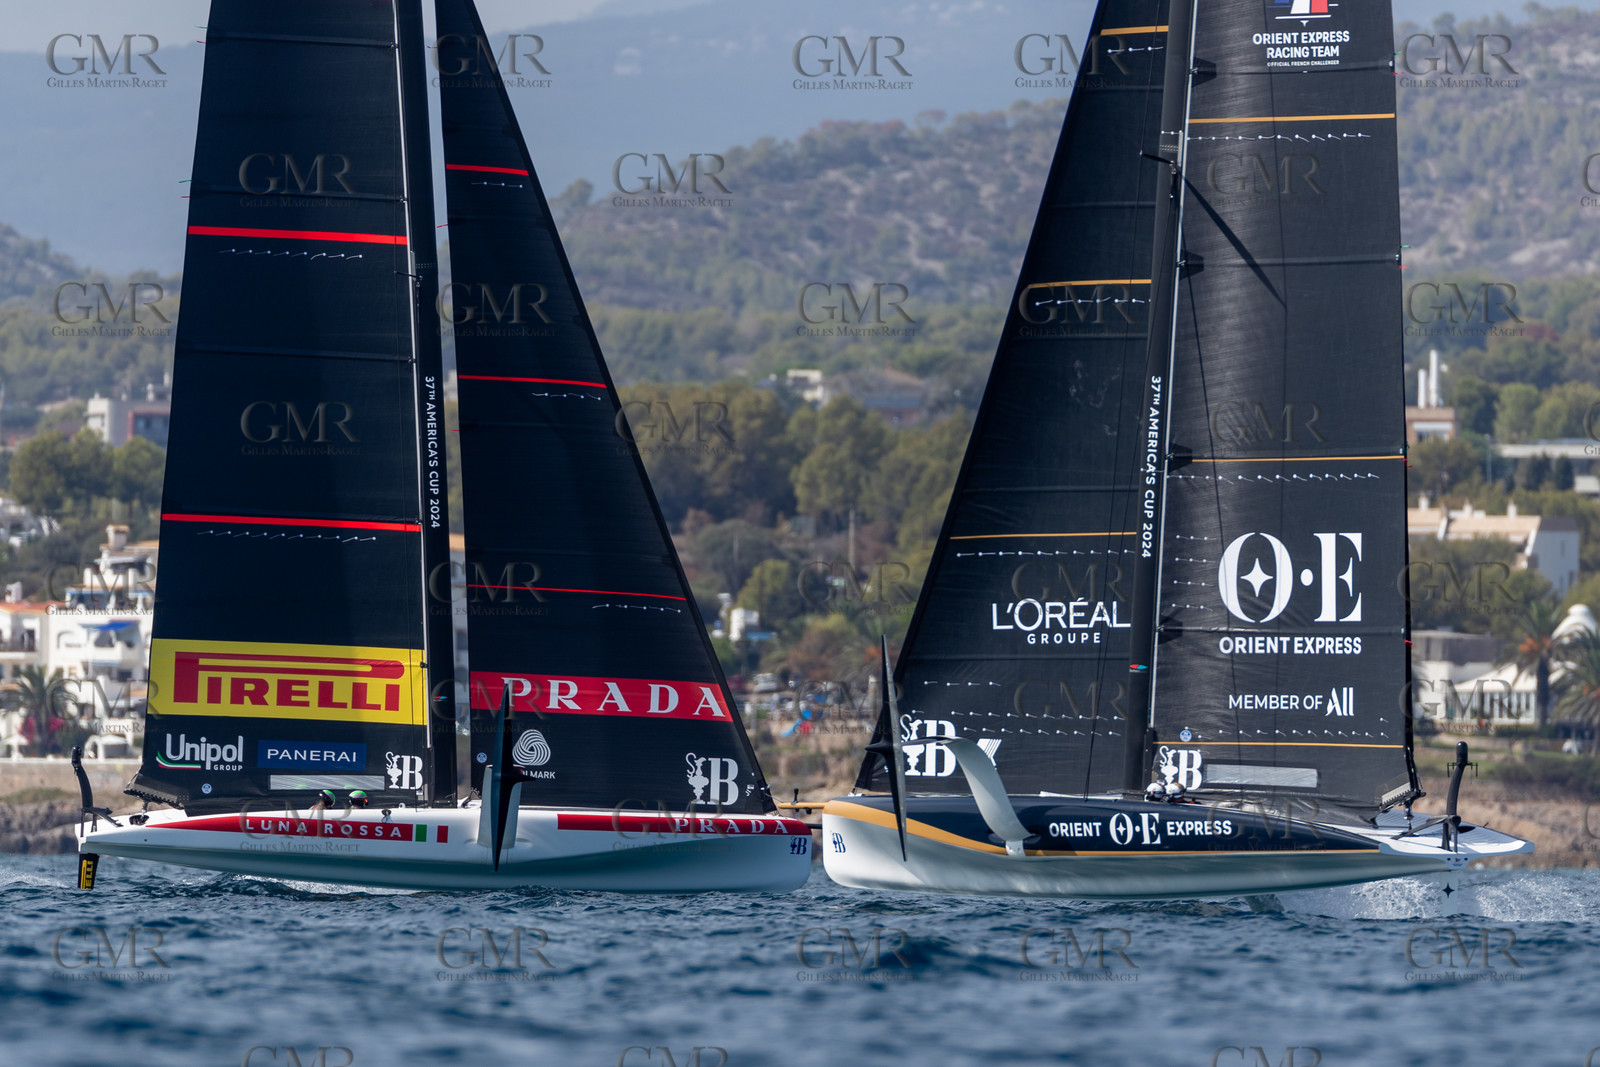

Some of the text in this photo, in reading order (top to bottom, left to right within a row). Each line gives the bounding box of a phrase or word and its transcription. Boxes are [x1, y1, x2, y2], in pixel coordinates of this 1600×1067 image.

[1252, 30, 1350, 45] ORIENT EXPRESS
[1266, 45, 1340, 59] RACING TEAM
[425, 375, 441, 529] 37TH AMERICA'S CUP 2024
[1141, 375, 1162, 559] 37TH AMERICA'S CUP 2024
[991, 597, 1132, 632] L'ORÉAL
[1026, 632, 1101, 645] GROUPE
[1219, 636, 1362, 654] ORIENT EXPRESS
[173, 651, 405, 712] PIRELLI
[500, 676, 726, 718] PRADA
[1228, 694, 1299, 710] MEMBER
[1303, 694, 1324, 710] OF
[166, 733, 243, 770] Unipol
[267, 748, 357, 763] PANERAI
[245, 819, 402, 838] LUNA ROSSA
[675, 818, 789, 835] PRADA
[1049, 822, 1102, 838] ORIENT
[1166, 820, 1232, 836] EXPRESS
